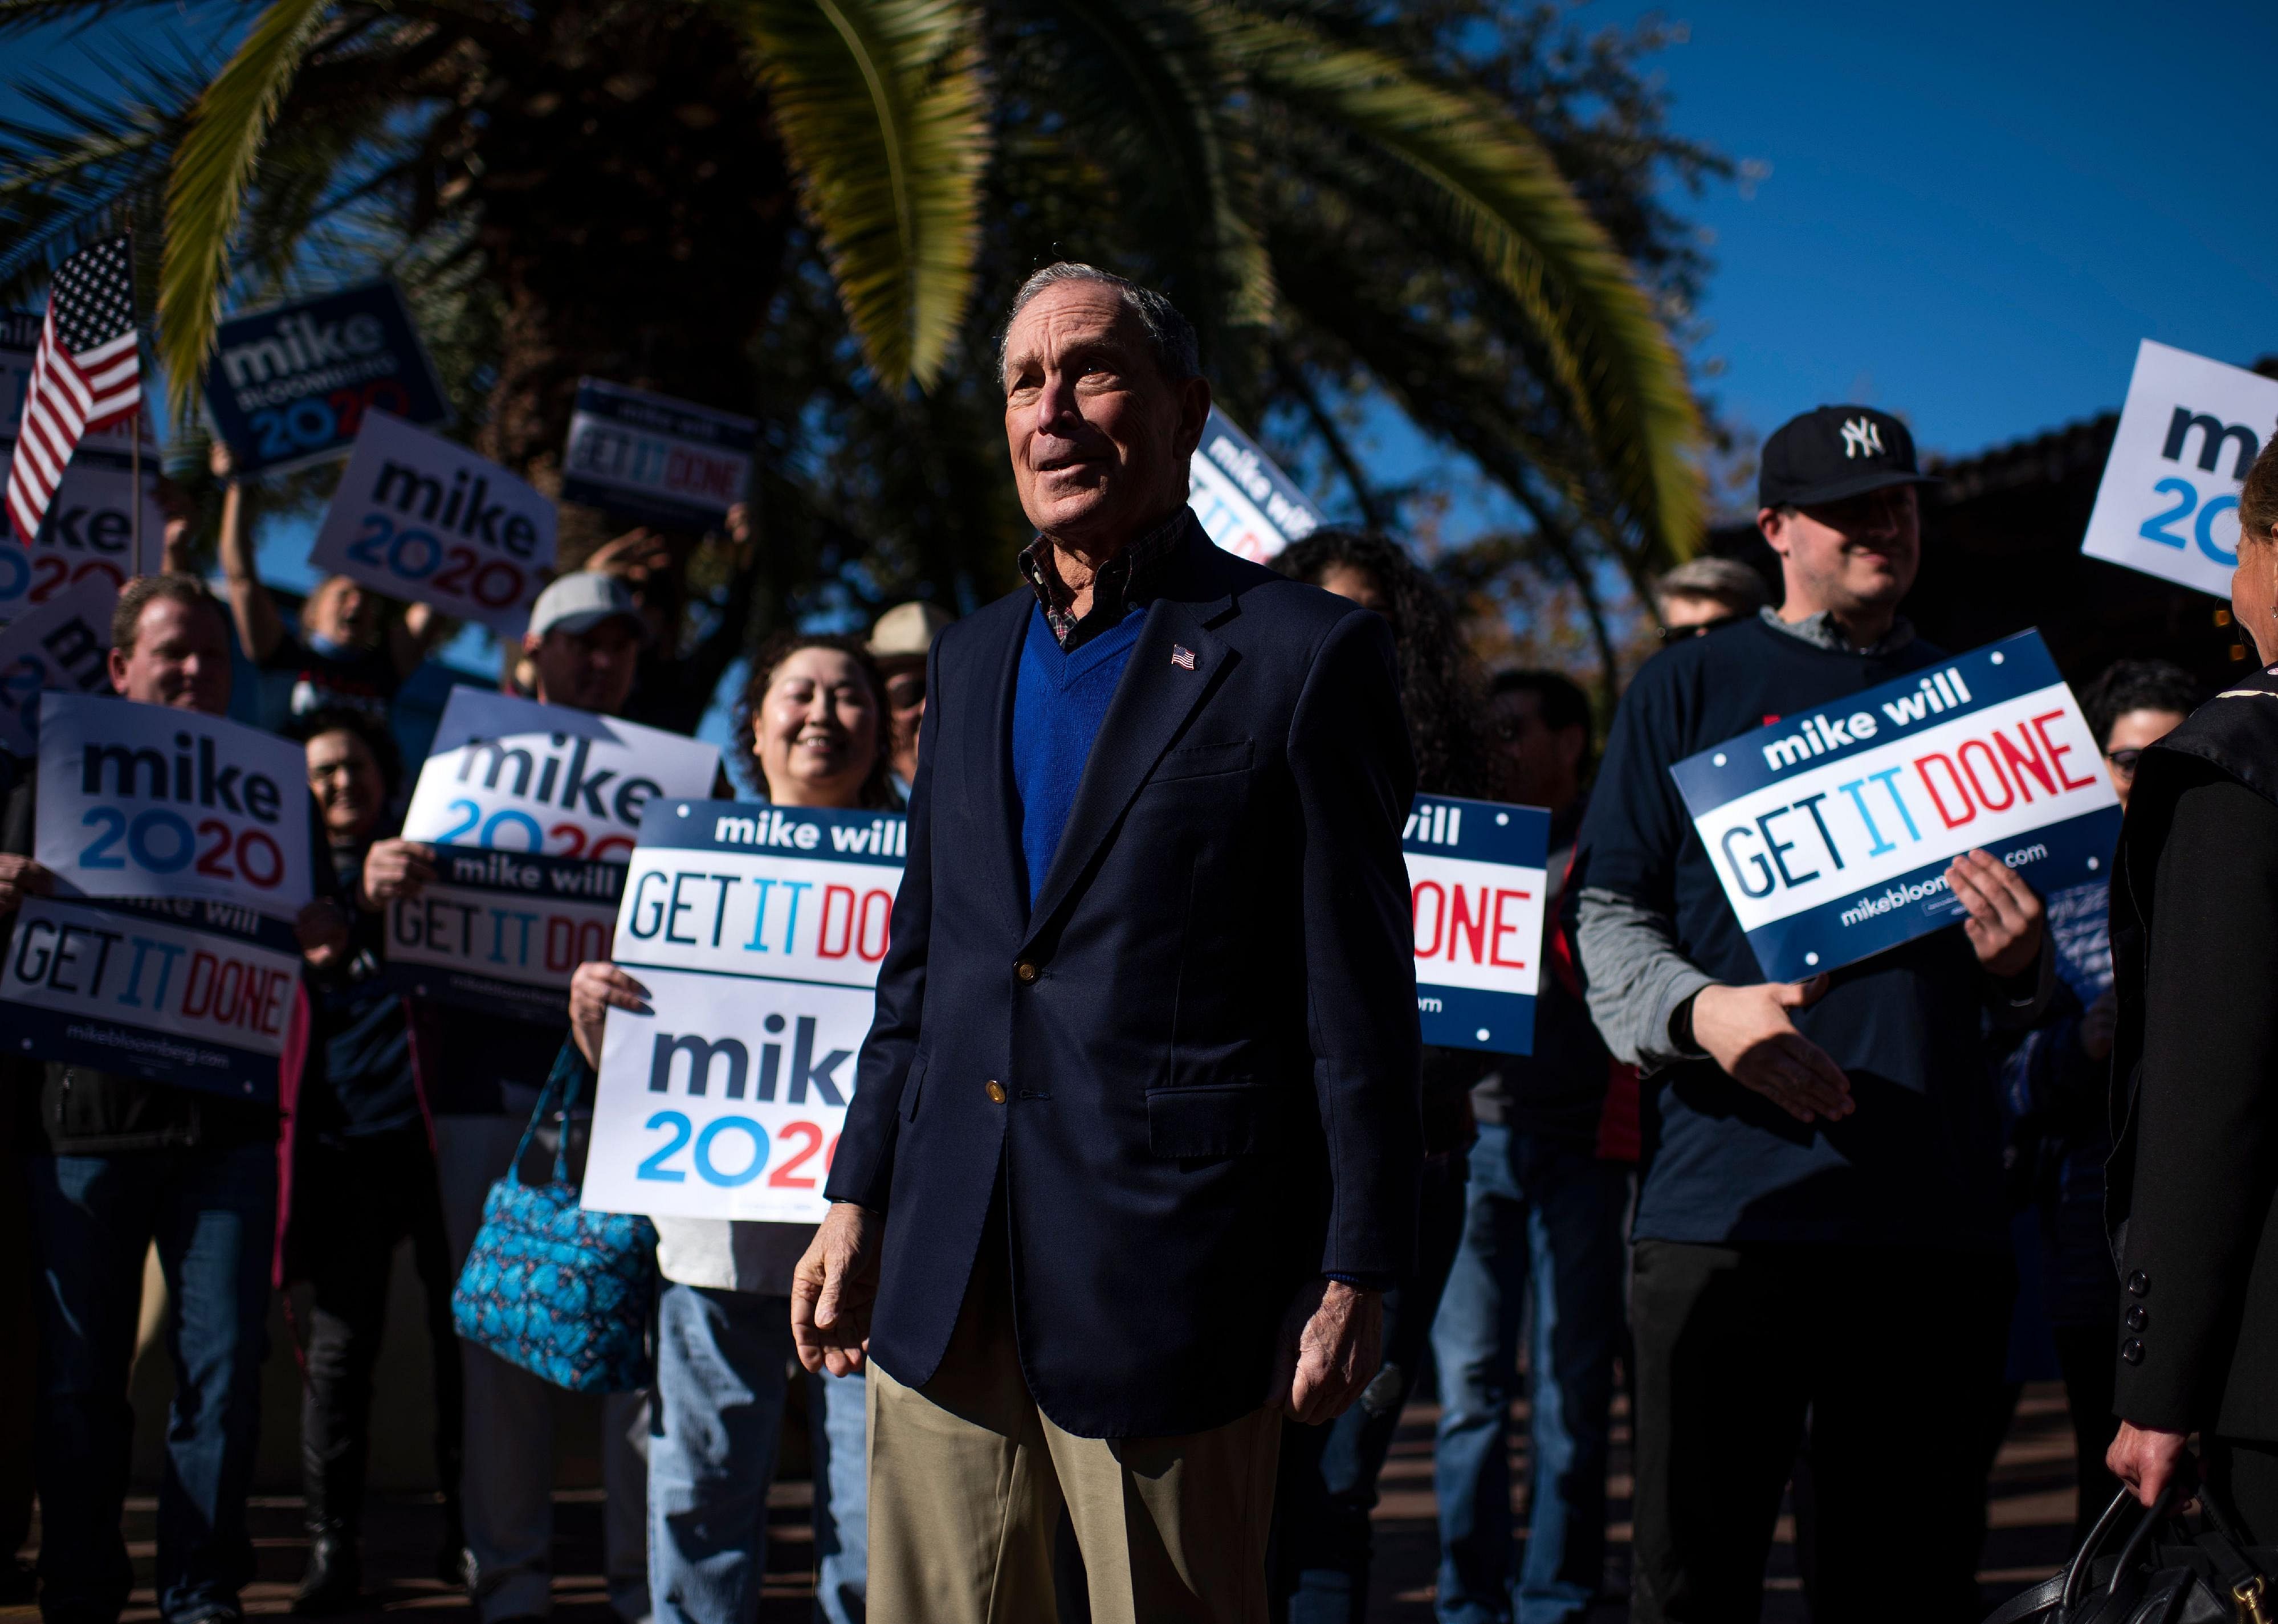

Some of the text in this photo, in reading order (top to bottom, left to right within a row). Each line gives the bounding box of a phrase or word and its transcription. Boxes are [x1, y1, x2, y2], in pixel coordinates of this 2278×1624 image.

[221, 311, 385, 389] mike
[247, 377, 411, 459] 2020
[373, 460, 536, 557] mike
[1207, 435, 1272, 501] mike
[347, 514, 523, 607] 2020
[2140, 478, 2242, 567] 20
[0, 547, 126, 603] 02
[1762, 667, 1973, 772] mike will
[83, 731, 280, 822] mike
[457, 729, 663, 827] mike
[1721, 709, 2097, 899] GET IT DONE
[79, 806, 284, 888] 2020
[452, 852, 617, 899] mike will
[714, 810, 906, 857] mike will
[629, 871, 895, 963] GET IT DO
[1412, 880, 1531, 970] ONE
[1840, 842, 2049, 928] mikebloomcom
[14, 916, 290, 1034] GET IT DONE
[393, 896, 616, 973] GET IT DO
[64, 1024, 230, 1070] mikebloomberg.com
[647, 1014, 857, 1107] mik
[637, 1111, 843, 1189] 202
